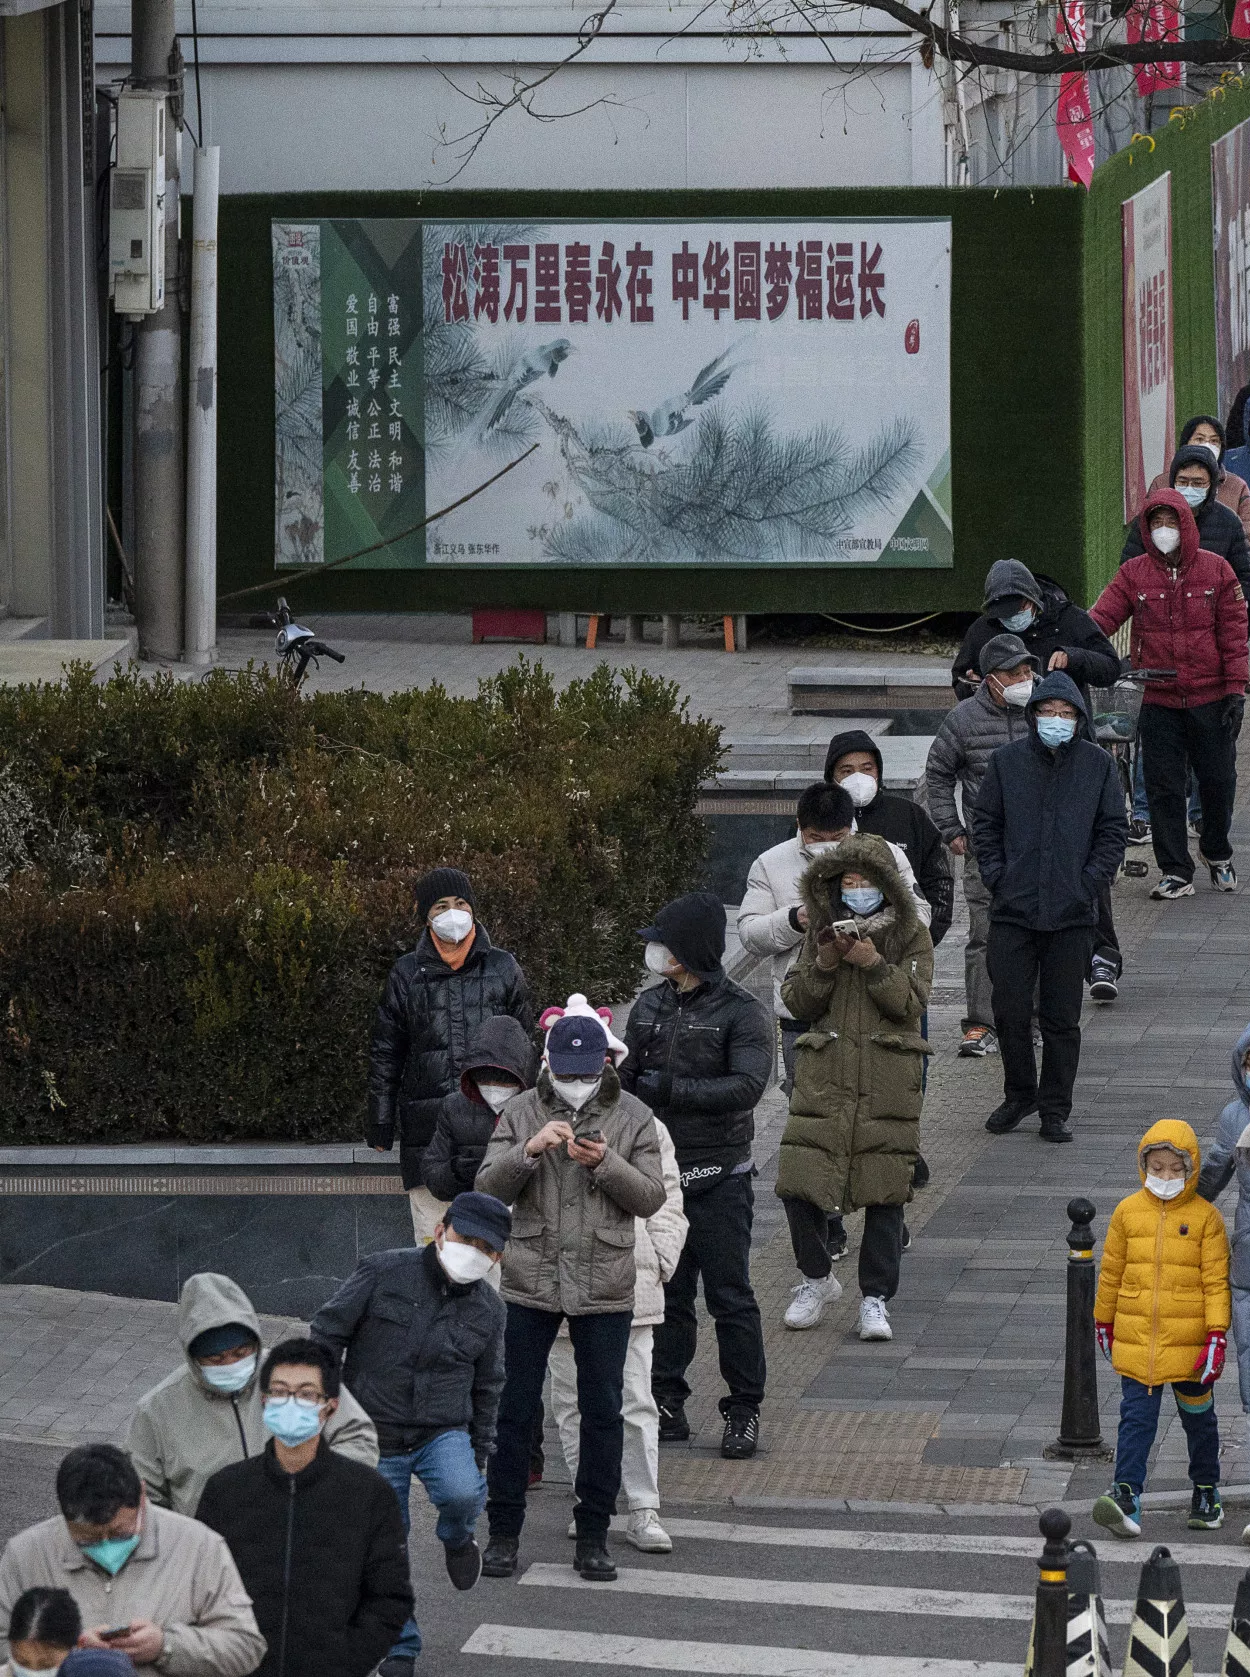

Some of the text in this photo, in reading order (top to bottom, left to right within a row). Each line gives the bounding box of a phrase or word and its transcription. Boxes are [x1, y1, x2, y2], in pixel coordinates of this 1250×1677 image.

[441, 240, 887, 324] 松涛万里春永在 中华圆梦福运长
[345, 293, 361, 493] 爱国 敬业 诚信 友善
[366, 292, 382, 493] 自由 平等 公正 法治
[387, 293, 404, 493] 富强 民主 文明 和谐
[680, 1166, 722, 1187] pion
